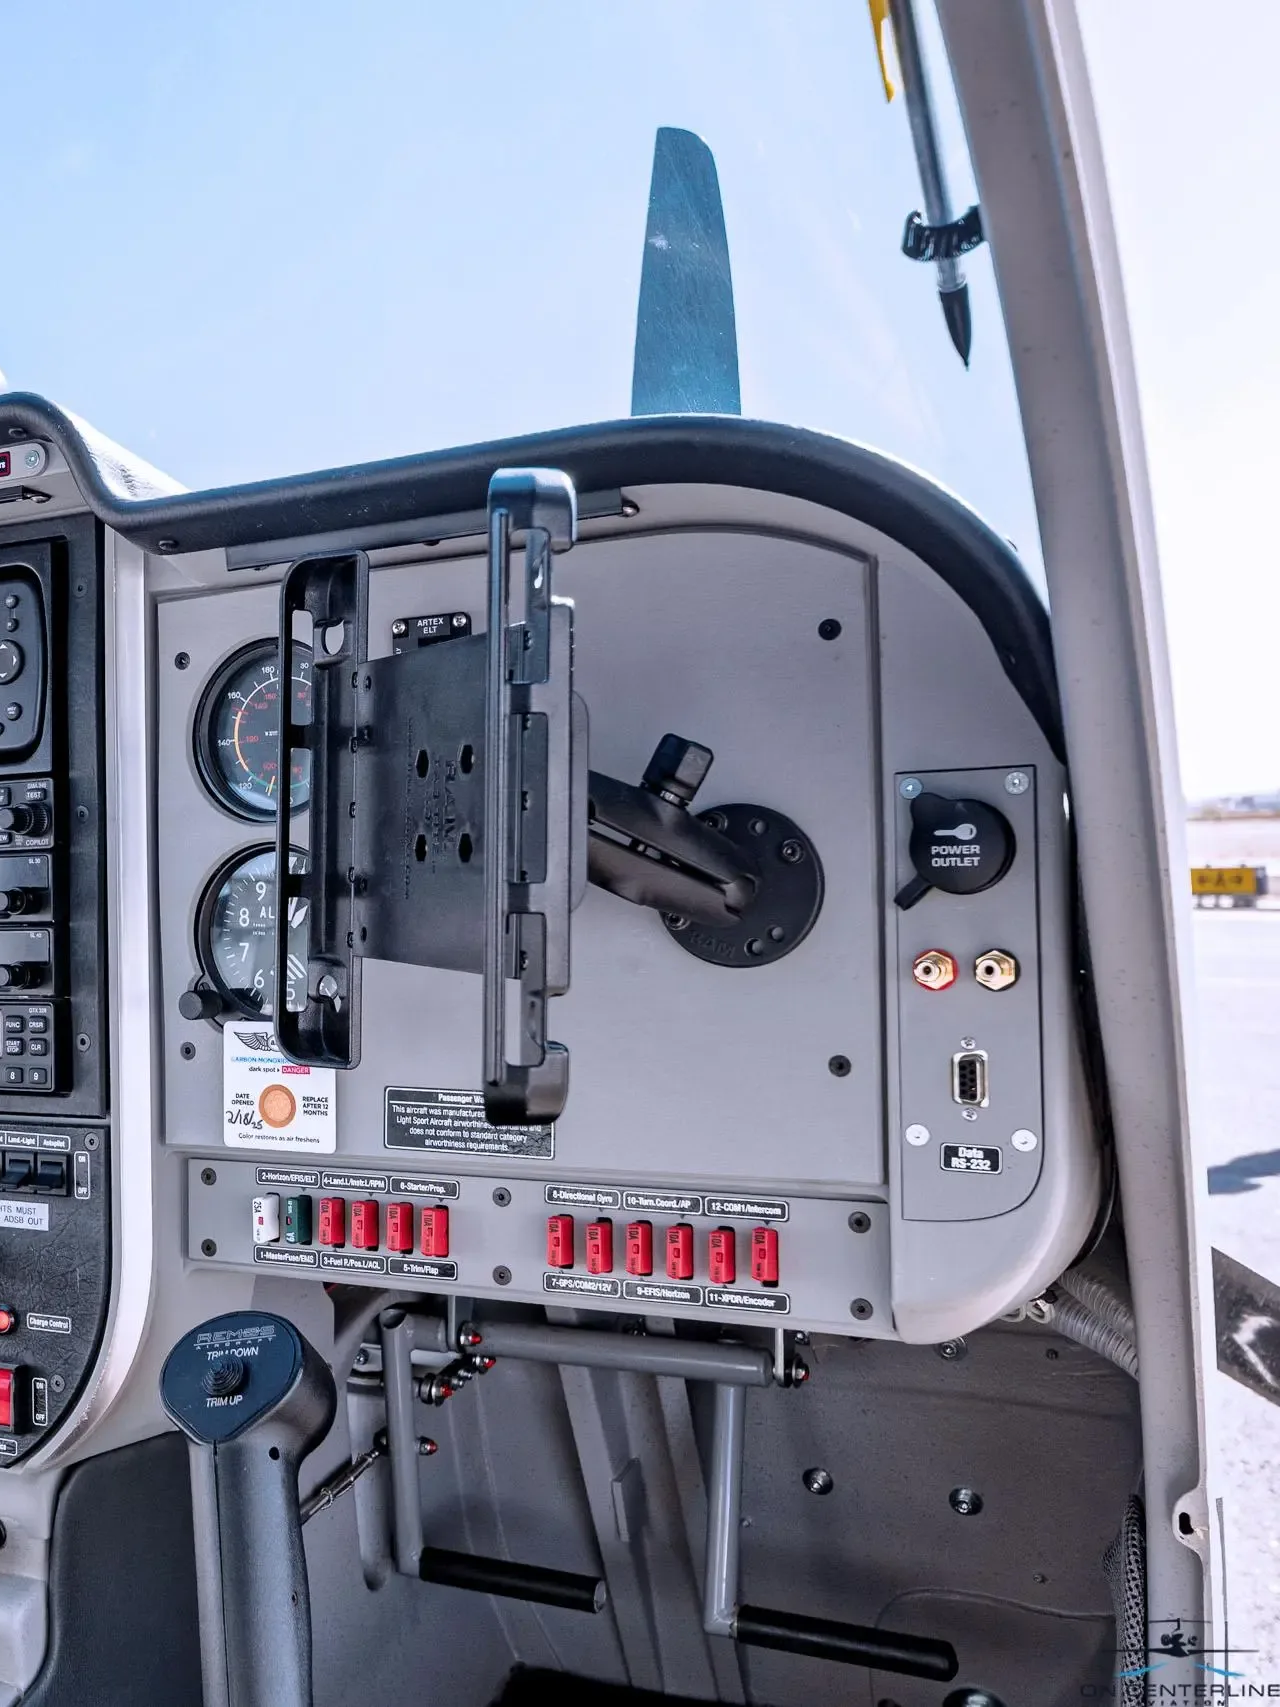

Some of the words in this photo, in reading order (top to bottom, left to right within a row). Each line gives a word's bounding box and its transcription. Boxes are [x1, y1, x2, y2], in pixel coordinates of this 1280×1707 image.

[417, 618, 444, 627] ARTEX
[423, 626, 437, 634] ELT
[261, 666, 275, 675] 180
[300, 662, 309, 670] 30
[227, 691, 241, 700] 160
[217, 739, 231, 747] 140
[238, 782, 252, 790] 120
[26, 791, 41, 799] TEST
[25, 838, 49, 846] COPILOT
[931, 845, 980, 855] POWER
[931, 857, 980, 867] OUTLET
[255, 881, 266, 901] 9
[239, 908, 250, 927] 8
[239, 943, 249, 962] 7
[254, 969, 265, 988] 6
[287, 981, 296, 1000] 5
[31, 1043, 41, 1051] CLR
[10, 1071, 16, 1080] 8
[33, 1072, 39, 1081] 9
[438, 1093, 472, 1104] Passenger
[392, 1105, 405, 1113] This
[406, 1106, 428, 1115] aircraft
[429, 1108, 441, 1116] was
[443, 1109, 485, 1118] manufactured
[396, 1115, 412, 1125] Light
[412, 1117, 429, 1127] Sport
[430, 1118, 452, 1127] Aircraft
[409, 1127, 423, 1135] does
[425, 1128, 435, 1136] not
[436, 1129, 461, 1138] conform
[463, 1130, 469, 1138] to
[470, 1131, 498, 1140] standard
[499, 1133, 527, 1143] category
[424, 1139, 466, 1149] airworthiness
[958, 1147, 984, 1158] Data
[951, 1157, 991, 1170] RS-232
[597, 1193, 613, 1204] Gyro
[16, 1206, 36, 1215] MUST
[4, 1215, 24, 1224] ADSB
[27, 1217, 43, 1225] OUT
[551, 1279, 612, 1292] 7-GPS/COM2/12V
[636, 1286, 691, 1299] 9-EFIS/Horizon
[709, 1293, 776, 1306] 11-XPDR/Encoder
[29, 1317, 48, 1328] Charge
[49, 1320, 69, 1329] Control
[197, 1325, 275, 1344] REMOS
[206, 1397, 228, 1408] TRIM
[229, 1395, 243, 1405] UP
[35, 1413, 45, 1421] OFF
